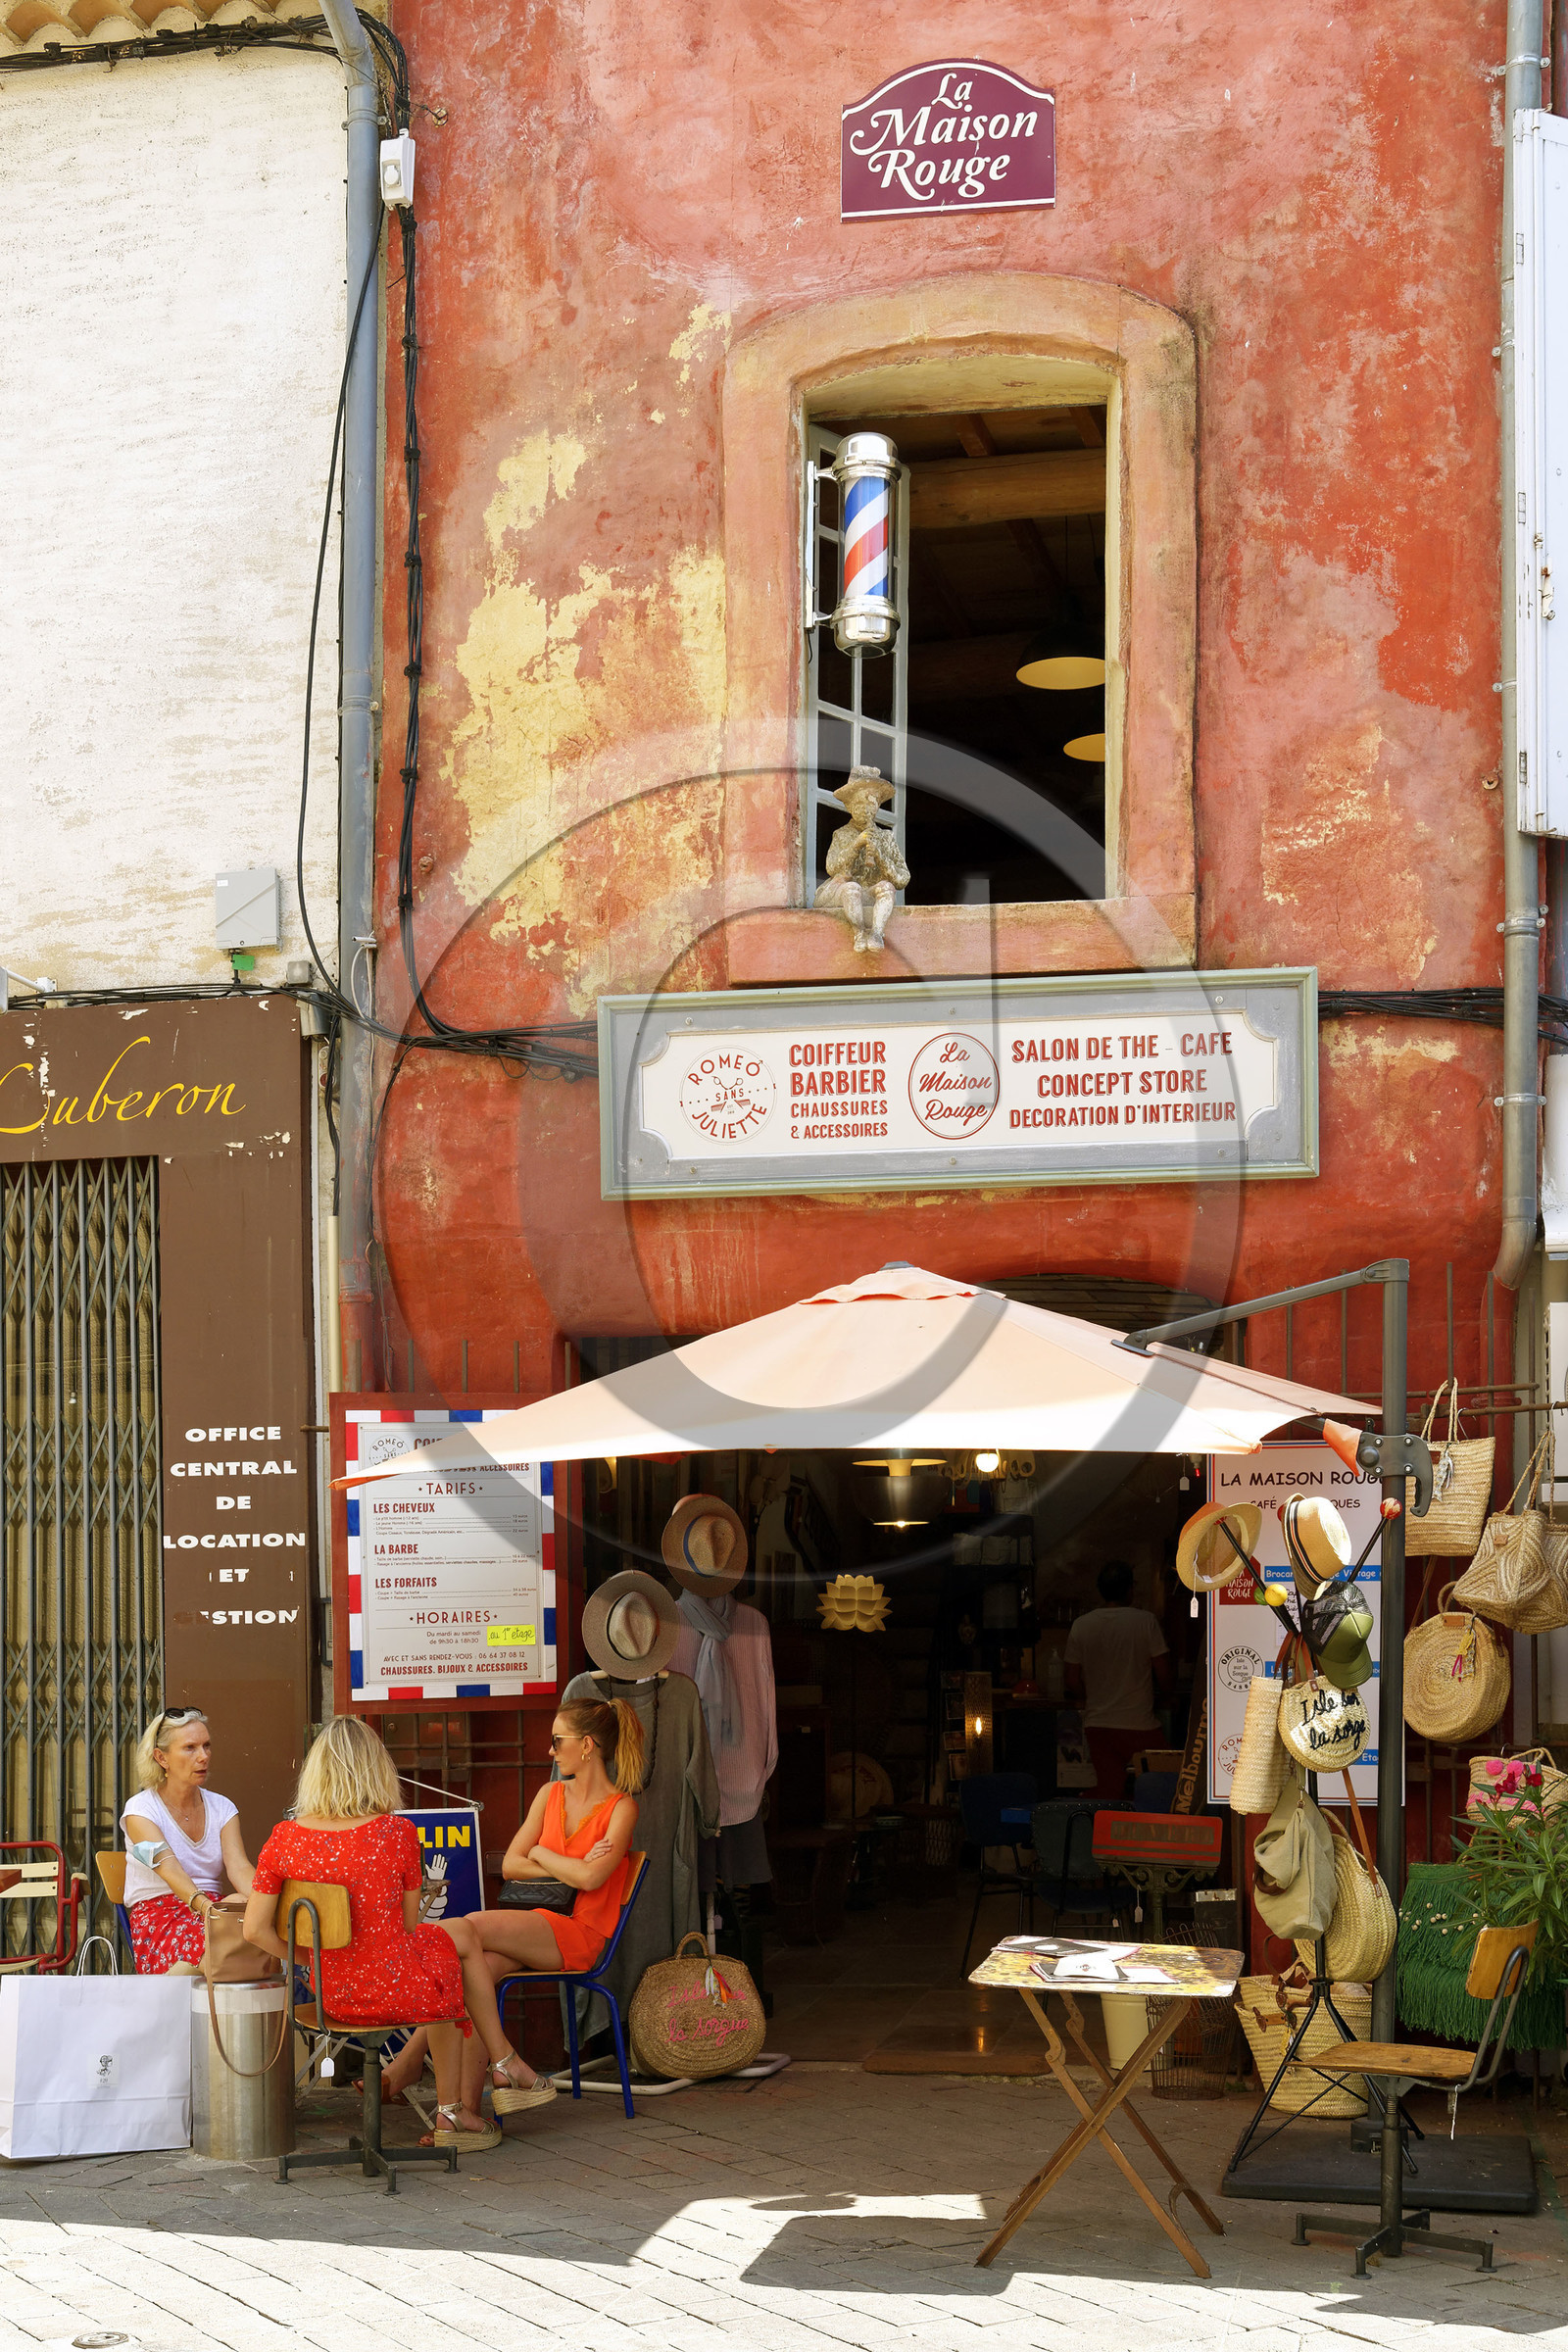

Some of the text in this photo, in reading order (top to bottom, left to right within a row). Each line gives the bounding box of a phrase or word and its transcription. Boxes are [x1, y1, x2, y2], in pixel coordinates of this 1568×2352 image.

[931, 73, 973, 110] La
[849, 104, 1038, 156] Maison
[867, 149, 1011, 201] Rouge
[789, 1041, 886, 1067] COIFFEUR
[939, 1041, 970, 1063] La
[1011, 1038, 1079, 1063] SALON
[1086, 1036, 1113, 1060] DE
[1117, 1034, 1159, 1059] THE
[1180, 1031, 1233, 1056] CAFE
[688, 1054, 761, 1086] ROMEO
[790, 1069, 887, 1097] BARBIER
[918, 1070, 993, 1093] Maison
[1037, 1068, 1207, 1098] CONCEPT STORE
[715, 1088, 745, 1102] SANS
[791, 1100, 888, 1118] CHAUSSURES
[924, 1099, 988, 1127] Rouge
[1009, 1102, 1236, 1129] DECORATION D'INTERIEUR
[691, 1102, 767, 1139] JULIETTE
[791, 1122, 888, 1139] & ACCESSOIRES
[184, 1426, 281, 1443] OFFICE
[372, 1438, 404, 1451] ROMEO
[170, 1460, 297, 1477] CENTRAL
[1220, 1471, 1383, 1487] LA MAISON ROUG
[426, 1482, 475, 1494] TARIFS
[216, 1495, 252, 1510] DE
[373, 1502, 435, 1513] LES CHEVEUX
[163, 1532, 306, 1549] LOCATION
[374, 1544, 418, 1554] LA BARBE
[219, 1568, 250, 1583] ET
[374, 1577, 437, 1589] LES FORFAITS
[1227, 1589, 1251, 1599] ROUGE
[200, 1609, 300, 1625] STION
[416, 1610, 491, 1624] HORAIRES
[1221, 1648, 1260, 1665] ORIGINAL
[437, 1664, 466, 1674] BIJOUX
[475, 1662, 528, 1672] ACCESSOIRES
[1300, 1689, 1336, 1726] Isle
[1309, 1727, 1331, 1750] la
[664, 2018, 750, 2047] la sorgue
